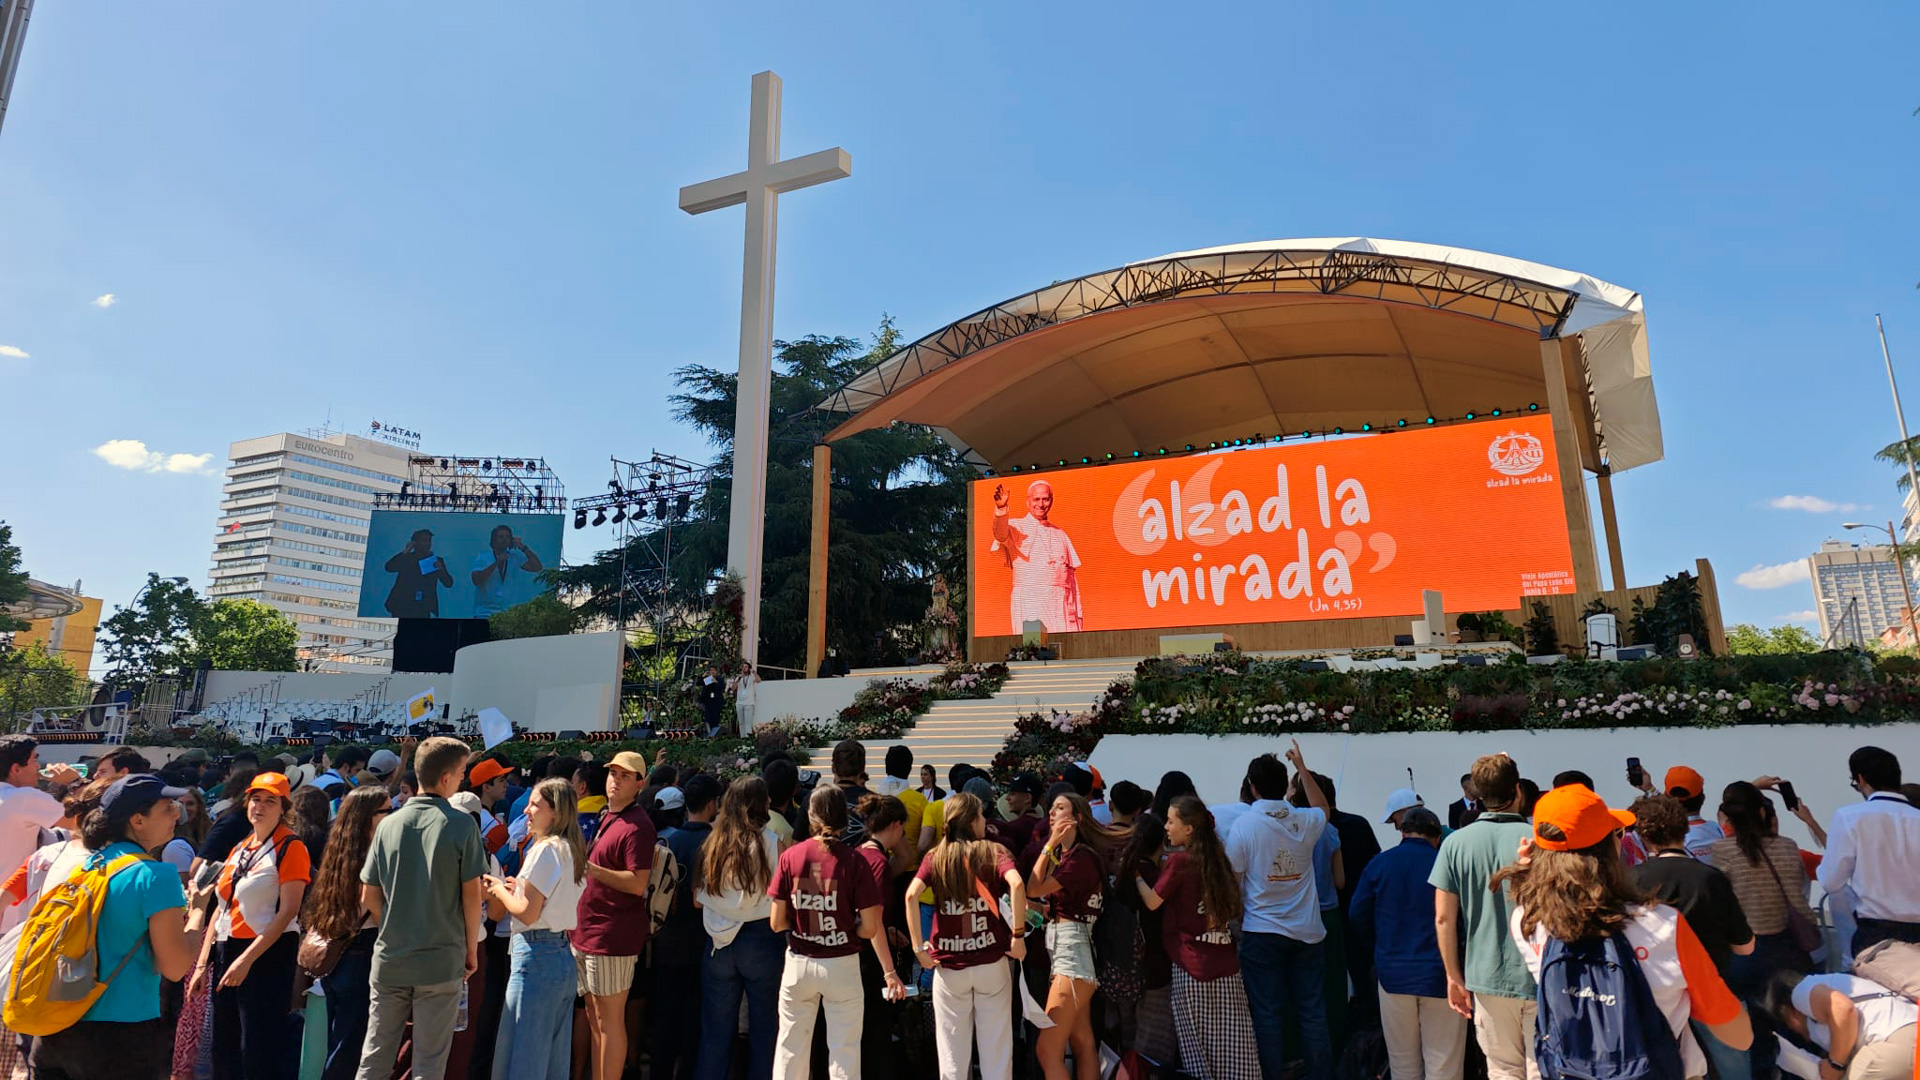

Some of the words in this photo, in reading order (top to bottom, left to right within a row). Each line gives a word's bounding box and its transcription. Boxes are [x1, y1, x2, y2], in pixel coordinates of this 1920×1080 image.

[384, 424, 421, 440] LATAM
[382, 434, 420, 448] AIRLINES
[1521, 472, 1553, 484] mirada
[1315, 464, 1371, 529] la
[1309, 598, 1330, 613] (Jn
[1333, 598, 1362, 612] 4,35)
[817, 912, 837, 931] la
[970, 913, 988, 933] la
[938, 931, 997, 952] mirada
